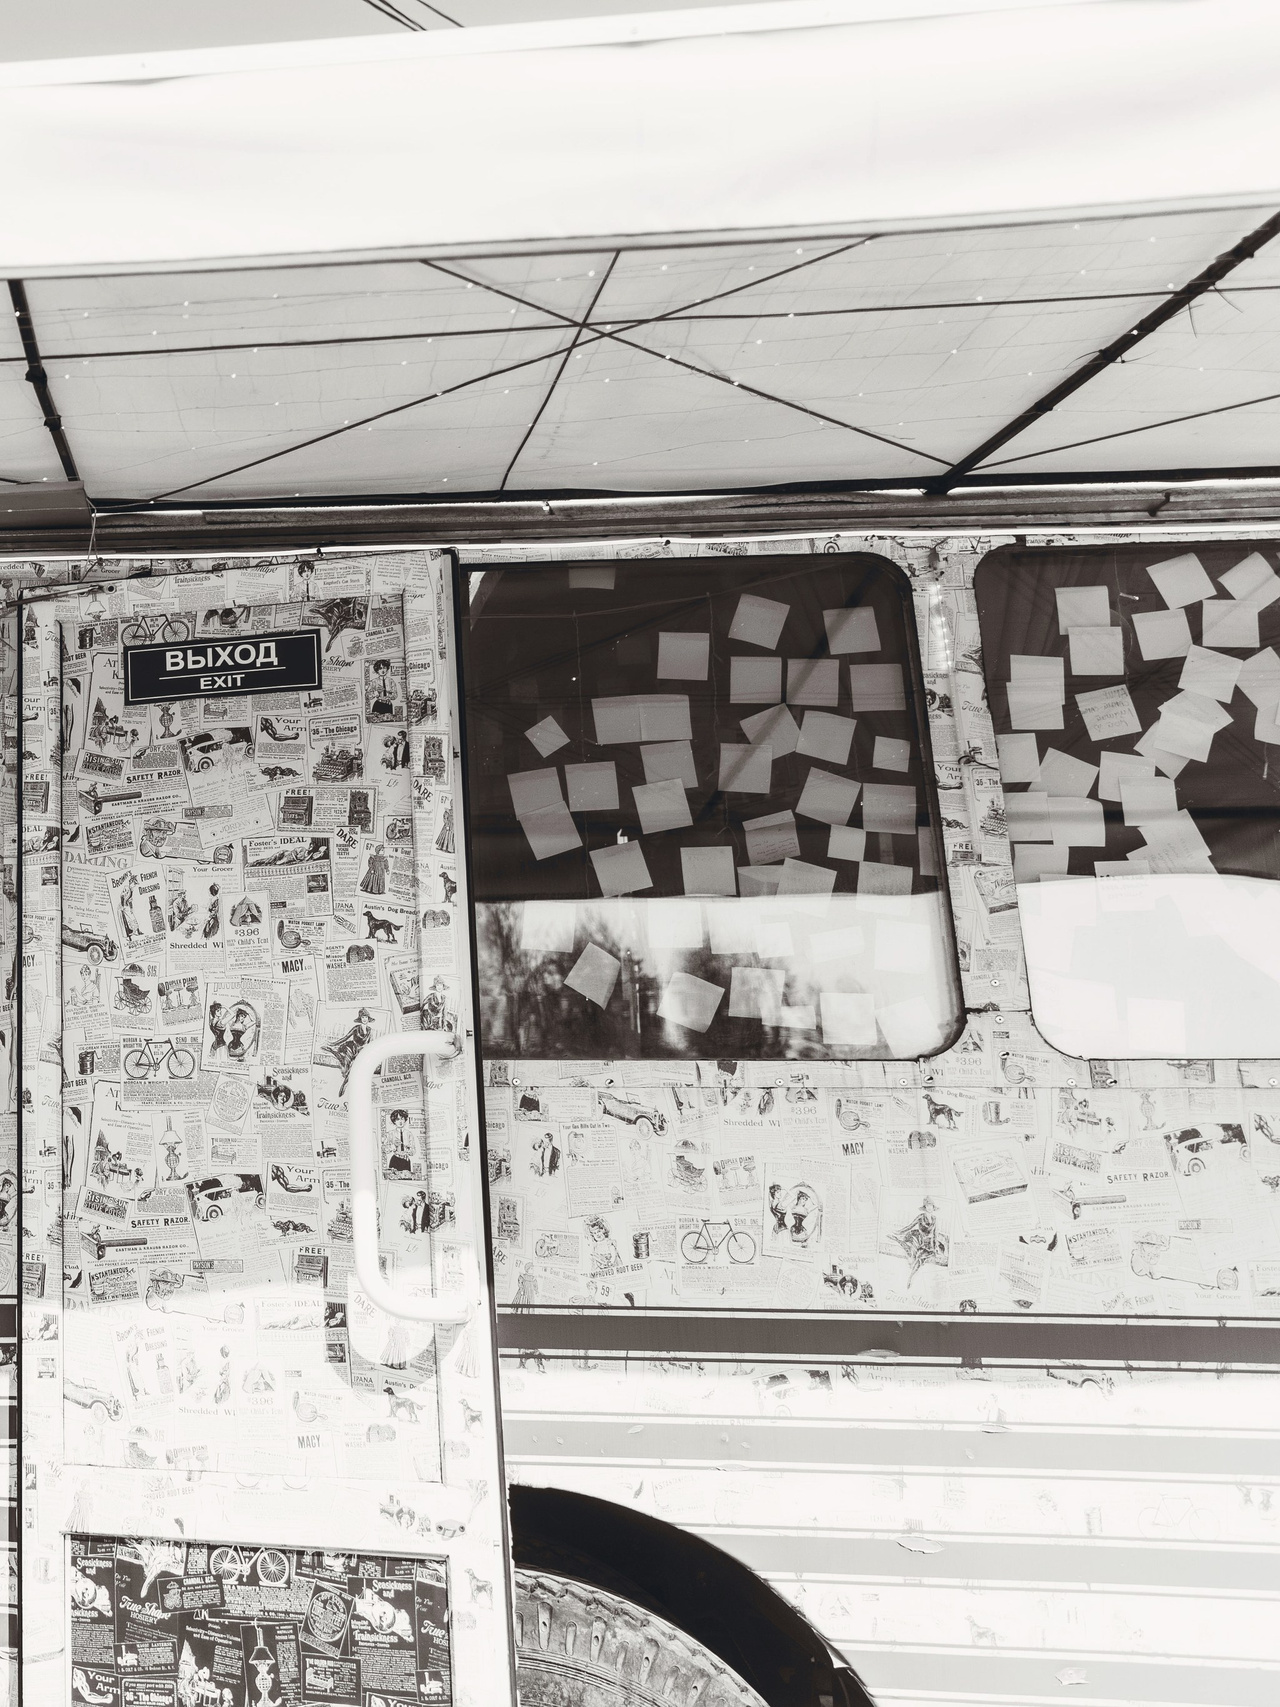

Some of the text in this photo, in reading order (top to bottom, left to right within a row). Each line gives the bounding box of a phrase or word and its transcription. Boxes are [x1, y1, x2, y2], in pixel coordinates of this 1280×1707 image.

[365, 628, 384, 638] CRANDALL
[74, 652, 87, 660] BEER
[165, 641, 279, 672] ВЫХОД
[200, 674, 246, 690] EXIT
[274, 717, 302, 725] Your
[335, 725, 357, 733] Chicago
[84, 752, 110, 766] RISING
[25, 773, 48, 781] FREE!
[126, 769, 184, 784] SAFETY RAZOR.
[987, 777, 1000, 786] The
[248, 836, 307, 847] Foster's IDEAL
[335, 827, 360, 850] DARE
[111, 870, 158, 889] BROWN'S FRENCH
[138, 883, 161, 896] DRESSING
[363, 903, 385, 911] Austin's
[169, 942, 208, 950] Shredded
[281, 958, 305, 974] MACY
[326, 962, 347, 970] WASHER
[164, 976, 198, 991] DUPLEX PIANO
[175, 1036, 188, 1044] SEND
[272, 1066, 309, 1077] Seasickness
[75, 1078, 88, 1087] BEER
[381, 1075, 402, 1084] CRANDALL
[317, 1097, 340, 1111] True
[254, 1111, 296, 1120] Trainsickness
[723, 1118, 764, 1128] Shredded
[841, 1141, 866, 1157] MACY
[720, 1155, 755, 1170] DUPLEX PIANO
[286, 1166, 314, 1175] Your
[295, 1175, 320, 1184] Arm
[1106, 1171, 1172, 1184] SAFETY RAZOR.
[86, 1190, 115, 1205] RISING
[130, 1216, 191, 1229] SAFETY RAZOR.
[298, 1247, 327, 1255] FREE!
[616, 1265, 630, 1275] ROOT
[630, 1263, 644, 1272] BEER
[1101, 1291, 1155, 1313] BROWN'S FRENCH
[1194, 1292, 1241, 1301] Your Grocer
[261, 1299, 323, 1308] Foster's IDEAL
[384, 1378, 407, 1389] Austin's
[76, 1557, 113, 1569] Seasickness
[85, 1566, 96, 1575] and
[372, 1579, 413, 1592] Seasickness
[382, 1590, 395, 1599] and
[119, 1595, 142, 1611] True
[129, 1612, 158, 1625] HOSIERY
[353, 1630, 399, 1644] Trainsickness
[87, 1670, 116, 1684] Your
[95, 1682, 120, 1695] Arm
[137, 1692, 174, 1705] The Chicago
